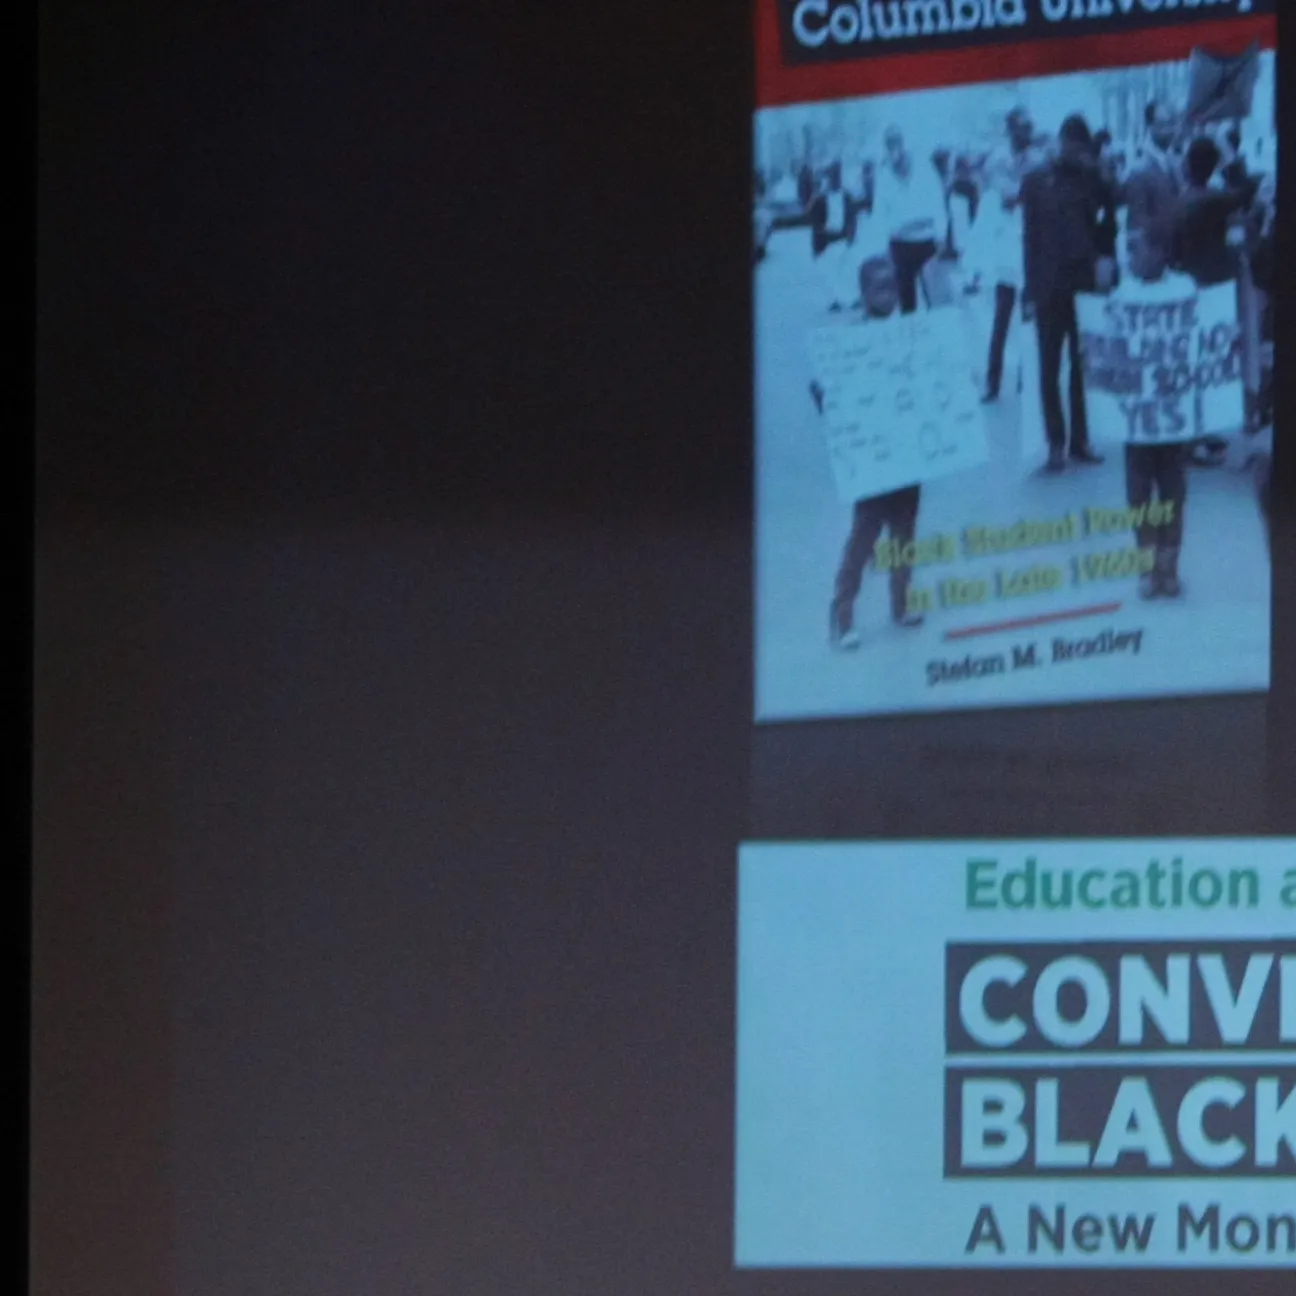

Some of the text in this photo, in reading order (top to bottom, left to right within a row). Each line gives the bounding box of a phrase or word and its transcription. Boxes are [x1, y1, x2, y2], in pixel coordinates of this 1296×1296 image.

[793, 0, 1027, 47] Columbia
[926, 629, 1143, 686] Stefan M. Bradley
[964, 857, 1260, 910] Education
[964, 1204, 1005, 1253] A
[1028, 1205, 1156, 1252] New
